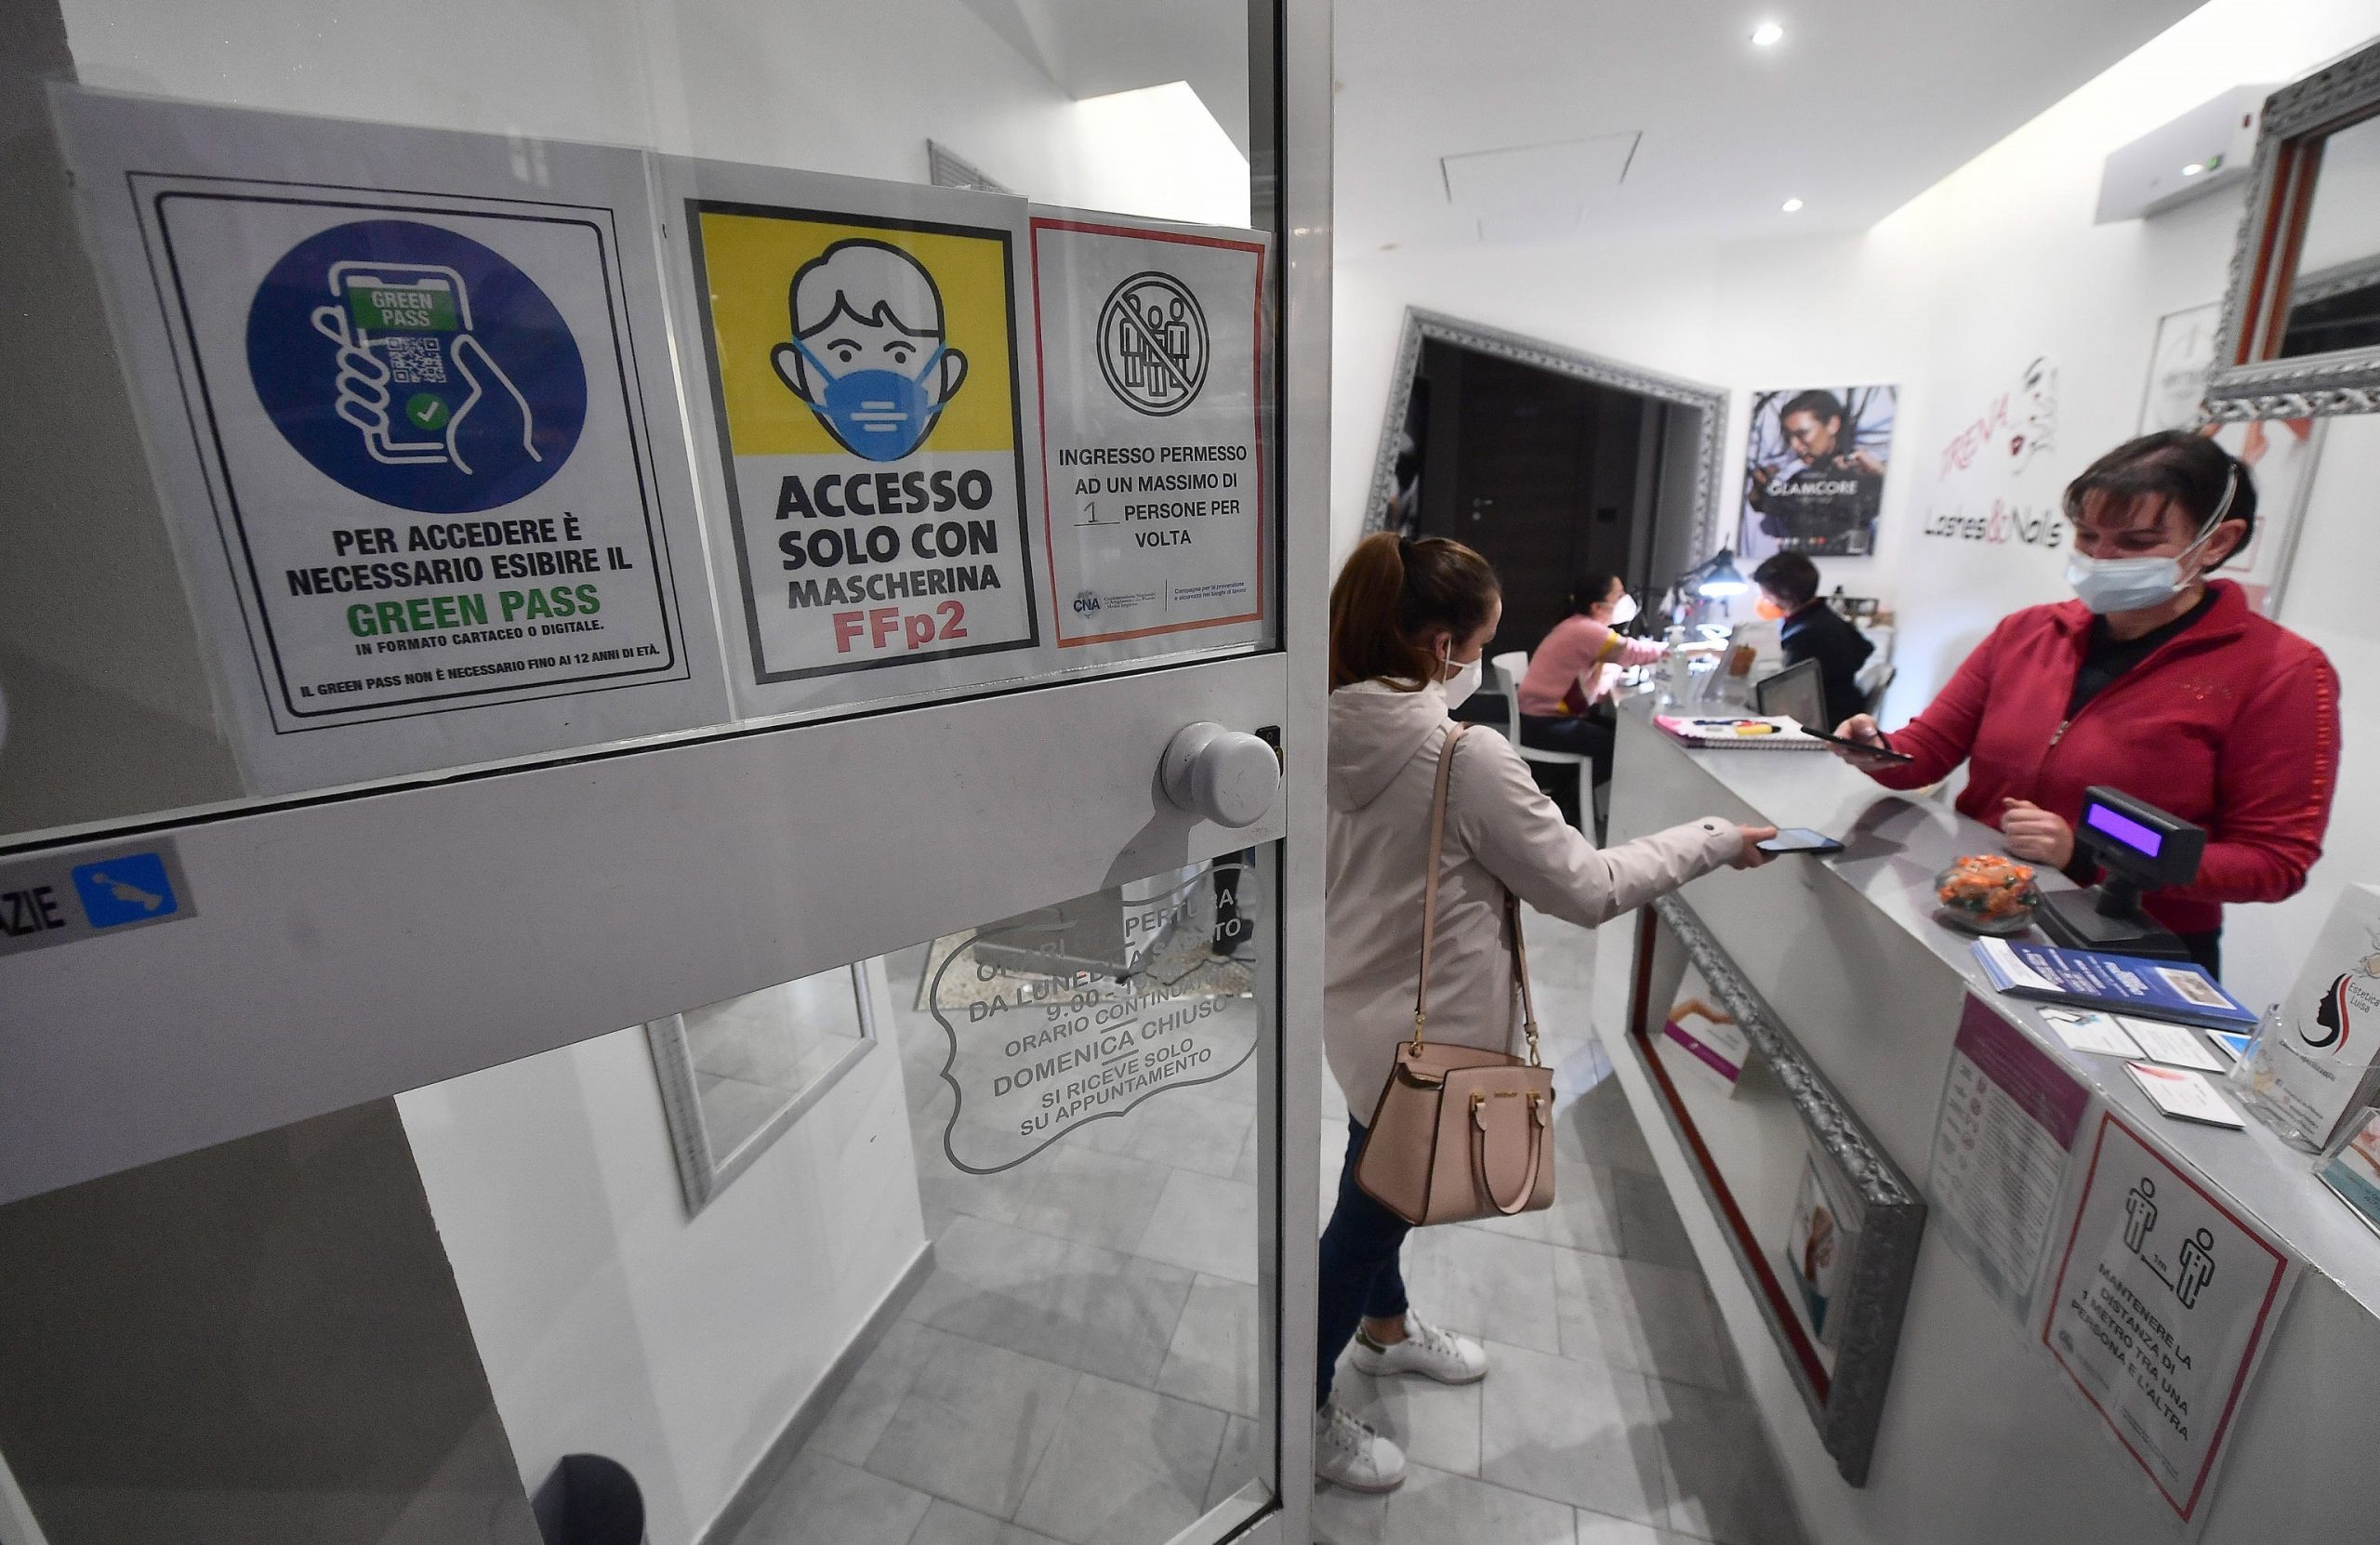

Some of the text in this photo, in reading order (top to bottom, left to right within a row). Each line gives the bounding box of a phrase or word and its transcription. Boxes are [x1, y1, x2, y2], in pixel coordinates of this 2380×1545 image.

[372, 291, 433, 309] GREEN
[381, 309, 430, 326] PASS
[1059, 445, 1247, 466] INGRESSO PERMESSO
[775, 469, 993, 520] ACCESSO
[1075, 473, 1237, 495] AD UN MASSIMO DI
[1083, 501, 1099, 522] 1
[1124, 499, 1240, 521] PERSONE PER
[332, 512, 582, 557] PER ACCEDERE È
[778, 520, 998, 570] SOLO CON
[1135, 530, 1192, 548] VOLTA
[286, 547, 633, 597] NECESSARIO ESIBIRE IL
[788, 564, 1001, 609] MASCHERINA
[347, 584, 602, 638] GREEN PASS
[833, 600, 968, 653] FFp2
[1073, 598, 1101, 614] CNA
[355, 620, 605, 656] IN FORMATO CARTACEO O DIGITALE.
[300, 643, 661, 698] IL GREEN PASS NON È NECESSARIO FINO AI 12 ANNI DI ETÀ.
[0, 886, 66, 937] ZIE
[969, 995, 1009, 1023] DA
[1015, 964, 1104, 1007] LUNED
[1047, 988, 1100, 1023] 9.00
[2348, 982, 2380, 1007] Estetica
[2350, 996, 2372, 1014] Luisa
[994, 997, 1228, 1097] DOMENICA CHIUSO
[1005, 1016, 1090, 1057] ORARIO
[1021, 1048, 1212, 1136] SU APPUNTAMENTO
[1041, 1037, 1194, 1109] SI RICEVE SOLO
[2097, 1260, 2174, 1349] MANTENERE
[2175, 1344, 2194, 1371] LA
[2099, 1285, 2160, 1358] DISTANZA
[2162, 1354, 2175, 1375] DI
[2070, 1296, 2126, 1368] PERSONA
[2127, 1362, 2135, 1378] E
[2136, 1373, 2190, 1443] L'ALTRA
[2081, 1288, 2087, 1301] 1
[2089, 1296, 2133, 1353] METRO
[2134, 1347, 2159, 1381] TRA
[2161, 1379, 2188, 1416] UNA
